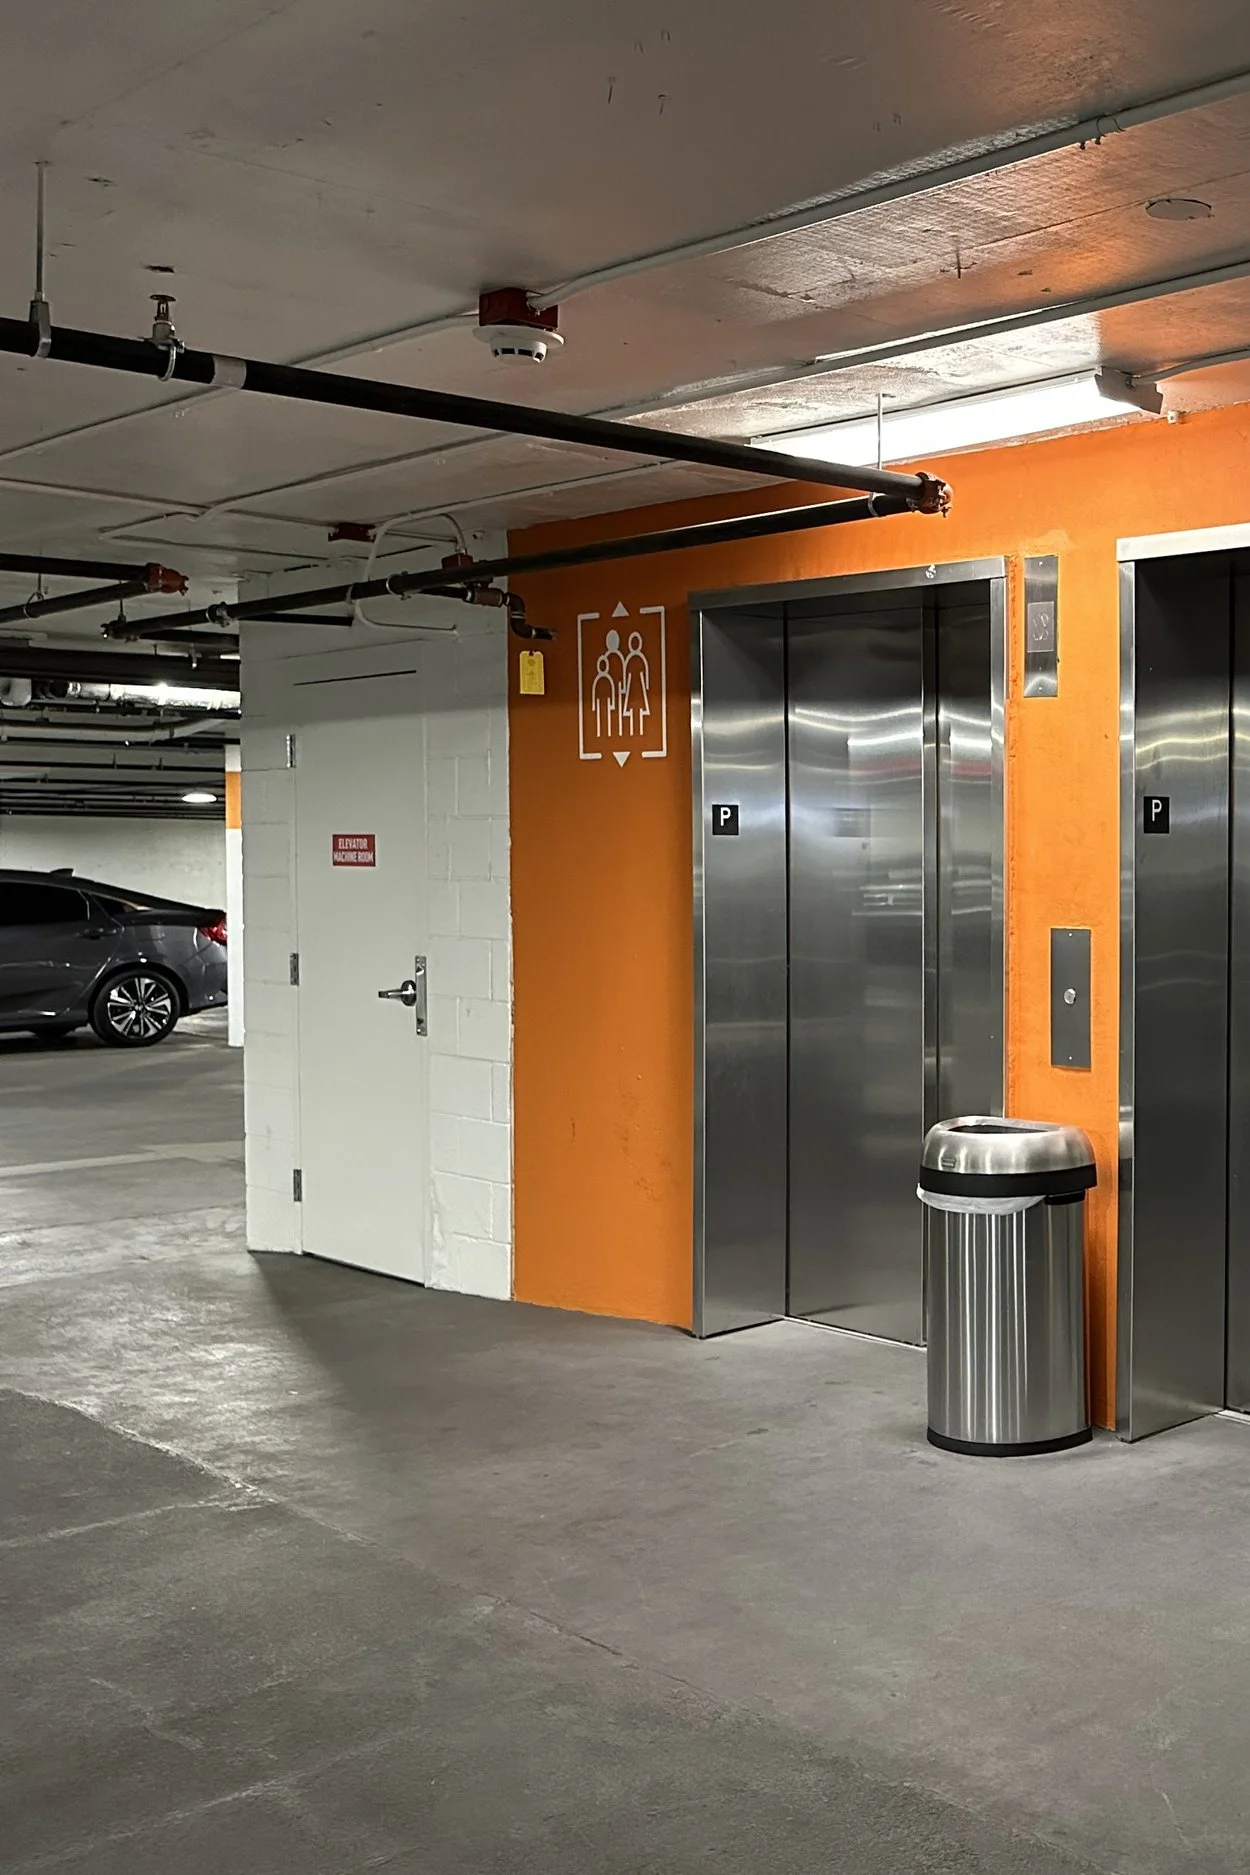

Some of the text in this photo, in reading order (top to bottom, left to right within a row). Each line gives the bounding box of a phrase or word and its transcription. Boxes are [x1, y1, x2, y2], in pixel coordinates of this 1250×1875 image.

[720, 807, 731, 827] P
[1151, 799, 1162, 822] P
[338, 838, 368, 850] ELEVATOR
